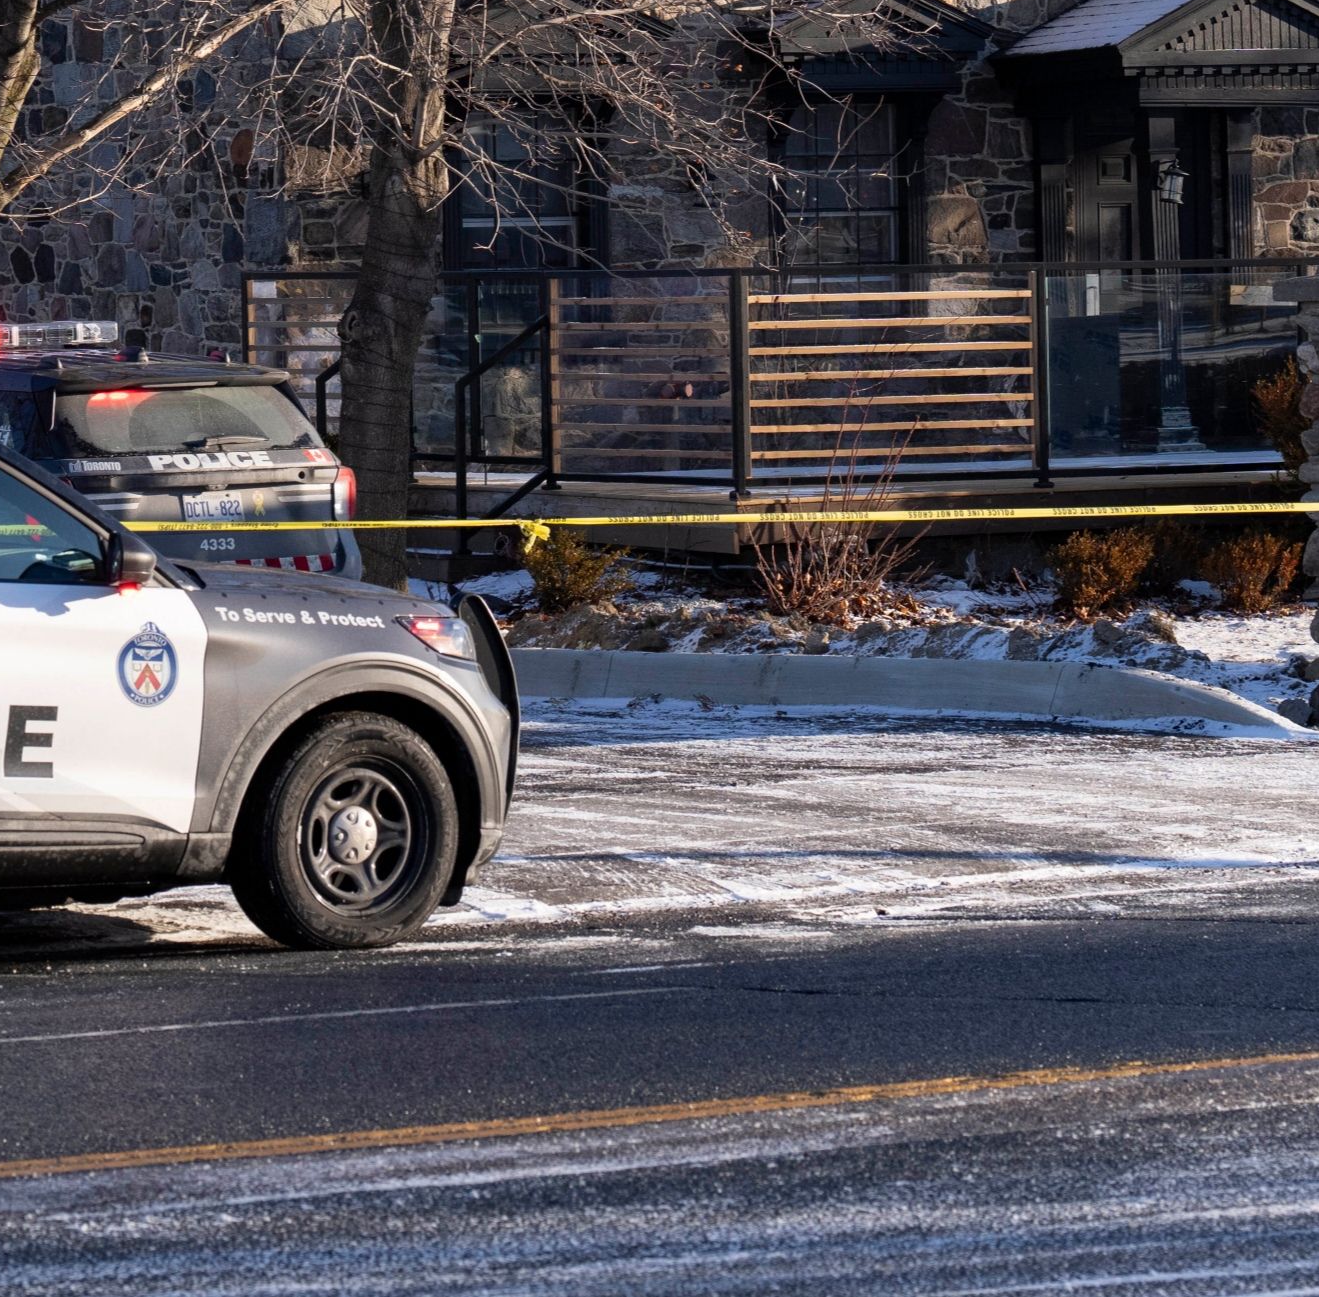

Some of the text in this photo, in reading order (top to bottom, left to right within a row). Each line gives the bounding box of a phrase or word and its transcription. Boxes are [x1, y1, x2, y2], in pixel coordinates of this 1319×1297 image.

[80, 451, 274, 471] TORONTO POLICE
[200, 537, 235, 551] 4333
[215, 606, 386, 628] To Serve & Protect
